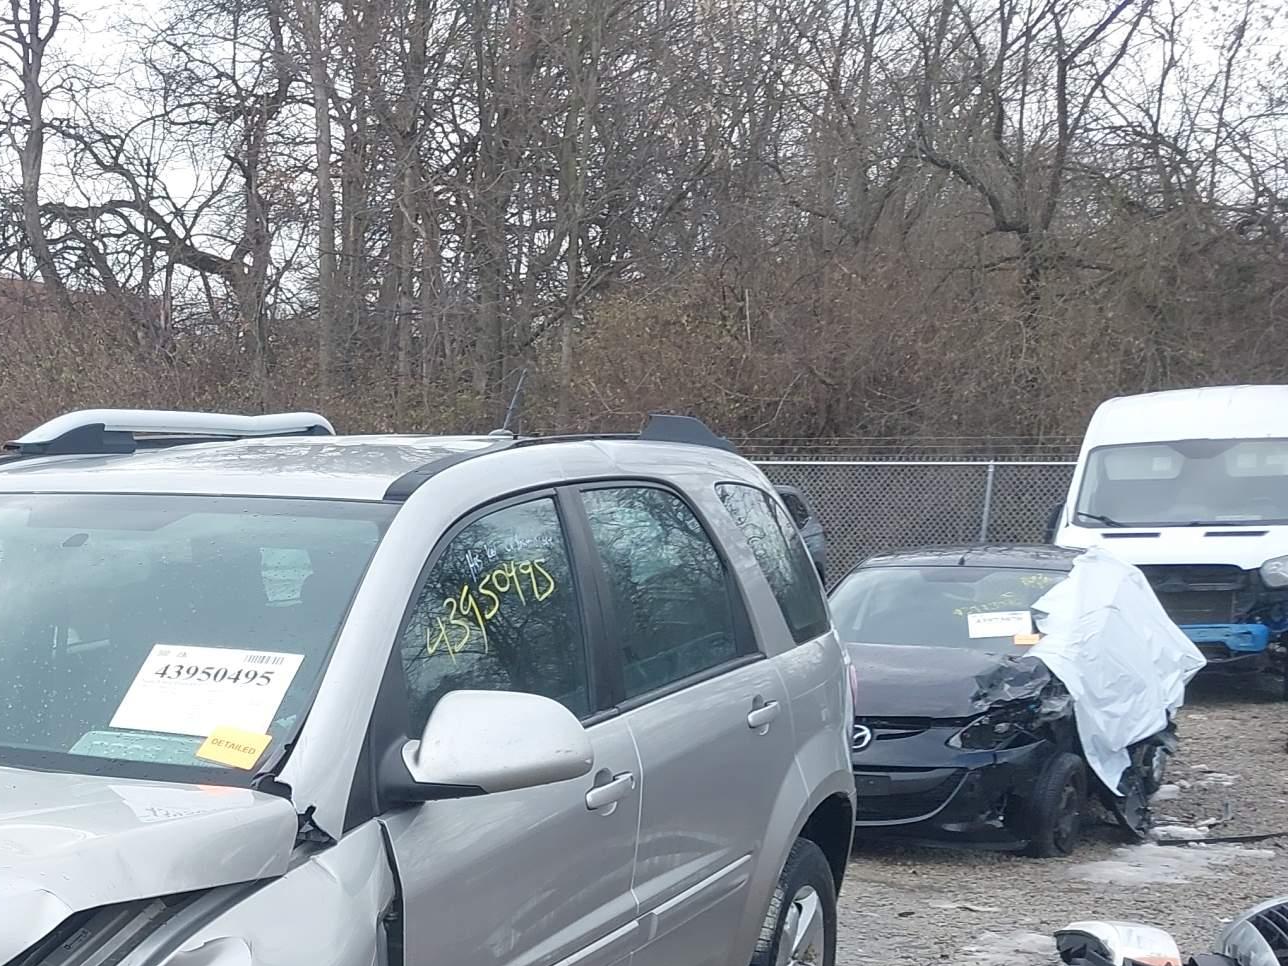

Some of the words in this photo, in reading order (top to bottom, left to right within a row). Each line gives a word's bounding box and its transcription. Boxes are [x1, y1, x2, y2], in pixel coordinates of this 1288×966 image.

[426, 559, 555, 665] 43950495
[154, 663, 276, 687] 43950495
[211, 738, 257, 755] DETAILED
